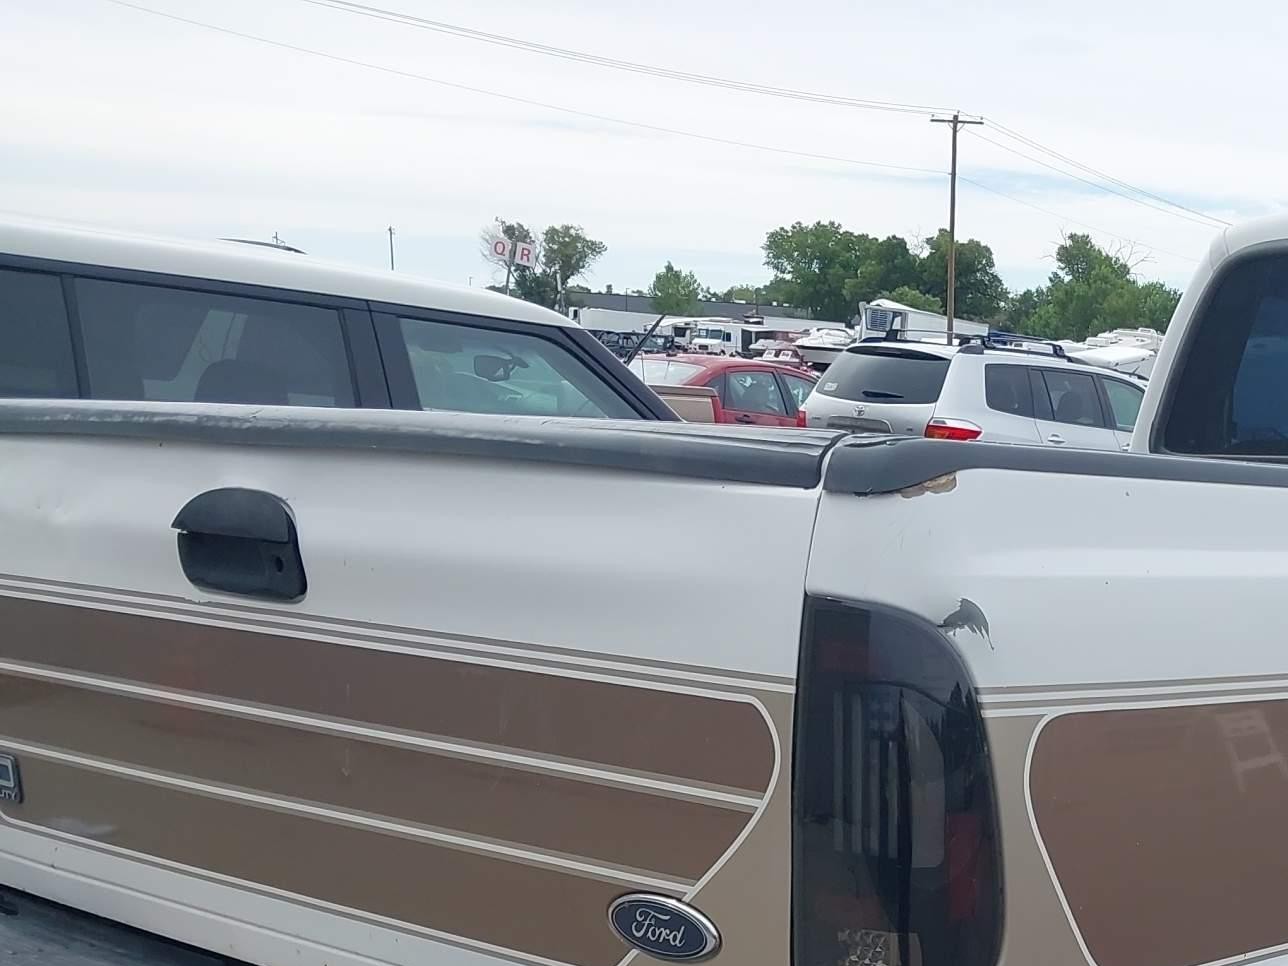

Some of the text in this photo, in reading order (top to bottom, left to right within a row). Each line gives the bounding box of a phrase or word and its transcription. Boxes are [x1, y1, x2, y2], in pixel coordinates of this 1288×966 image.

[494, 241, 506, 257] Q
[520, 247, 532, 263] R
[631, 907, 686, 947] Ford
